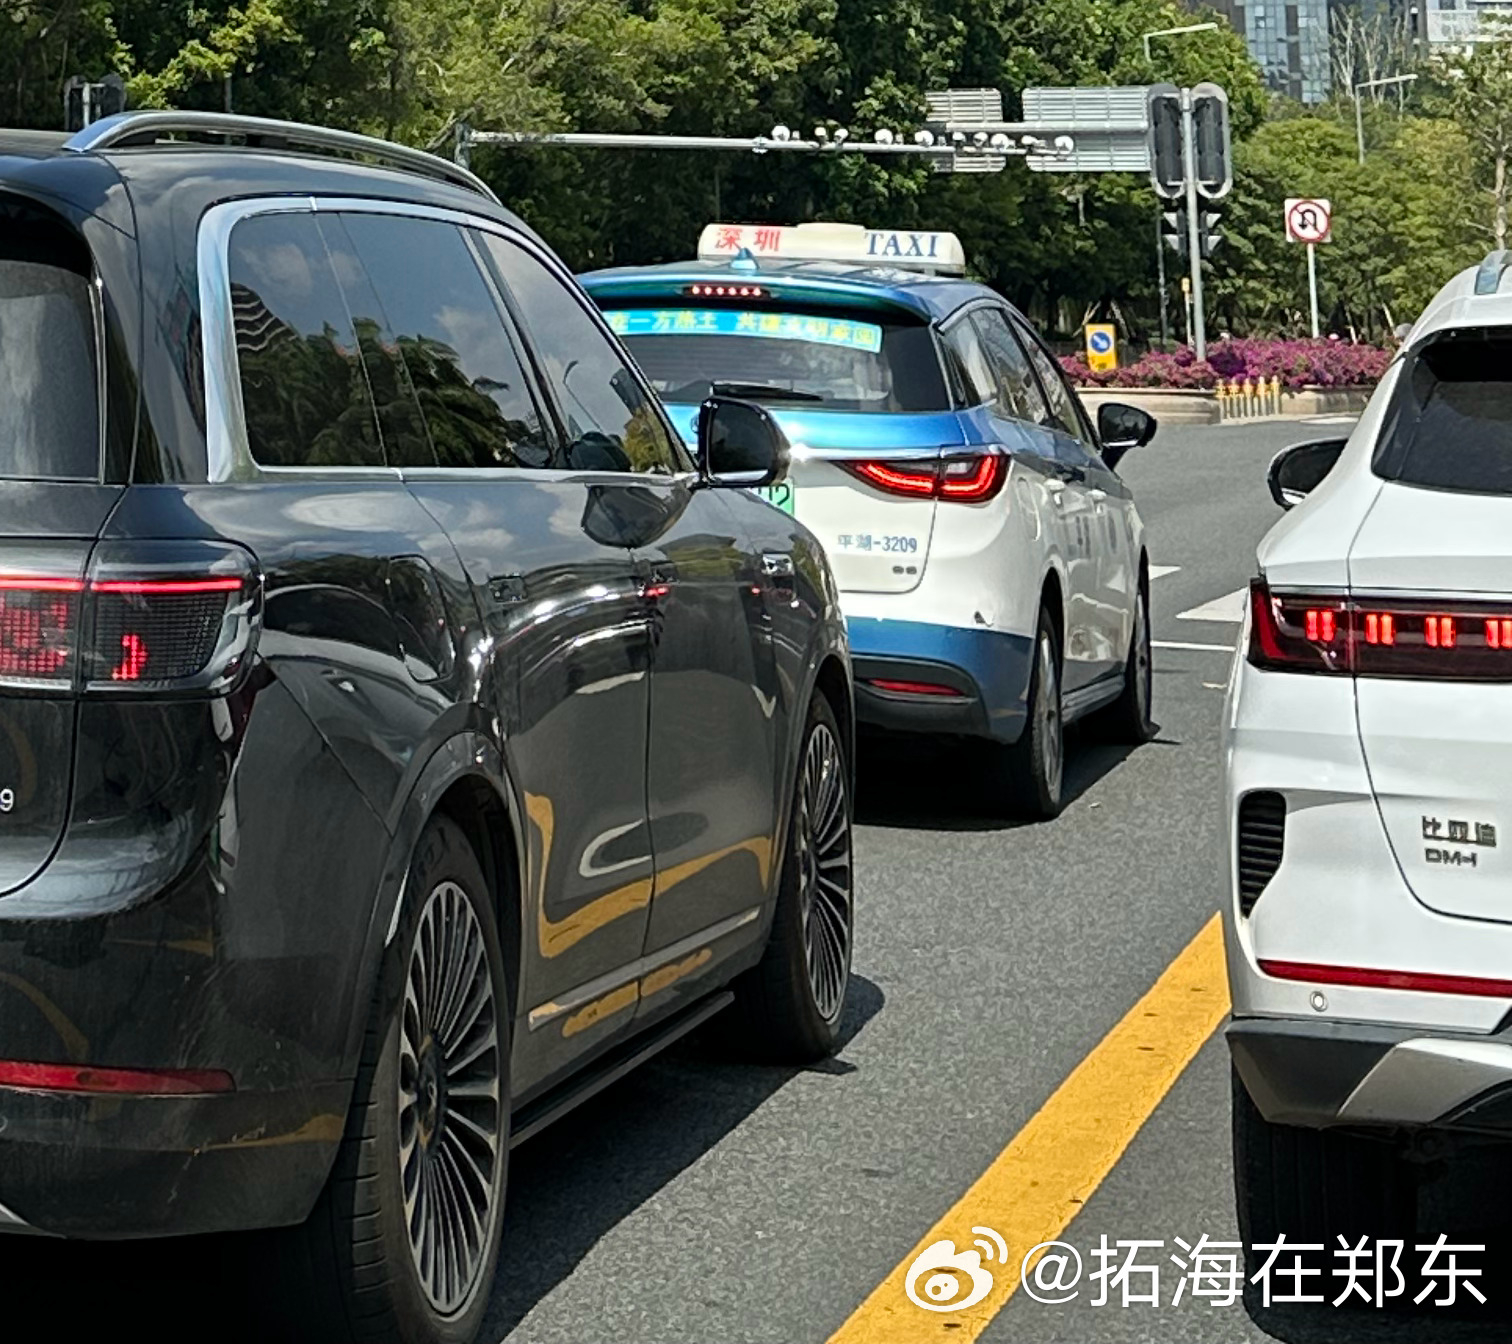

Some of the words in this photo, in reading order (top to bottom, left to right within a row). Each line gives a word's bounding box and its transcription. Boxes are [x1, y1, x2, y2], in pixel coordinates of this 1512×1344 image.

[715, 227, 782, 252] 深圳
[864, 233, 940, 257] TAXI
[1422, 815, 1496, 848] 比亚迪
